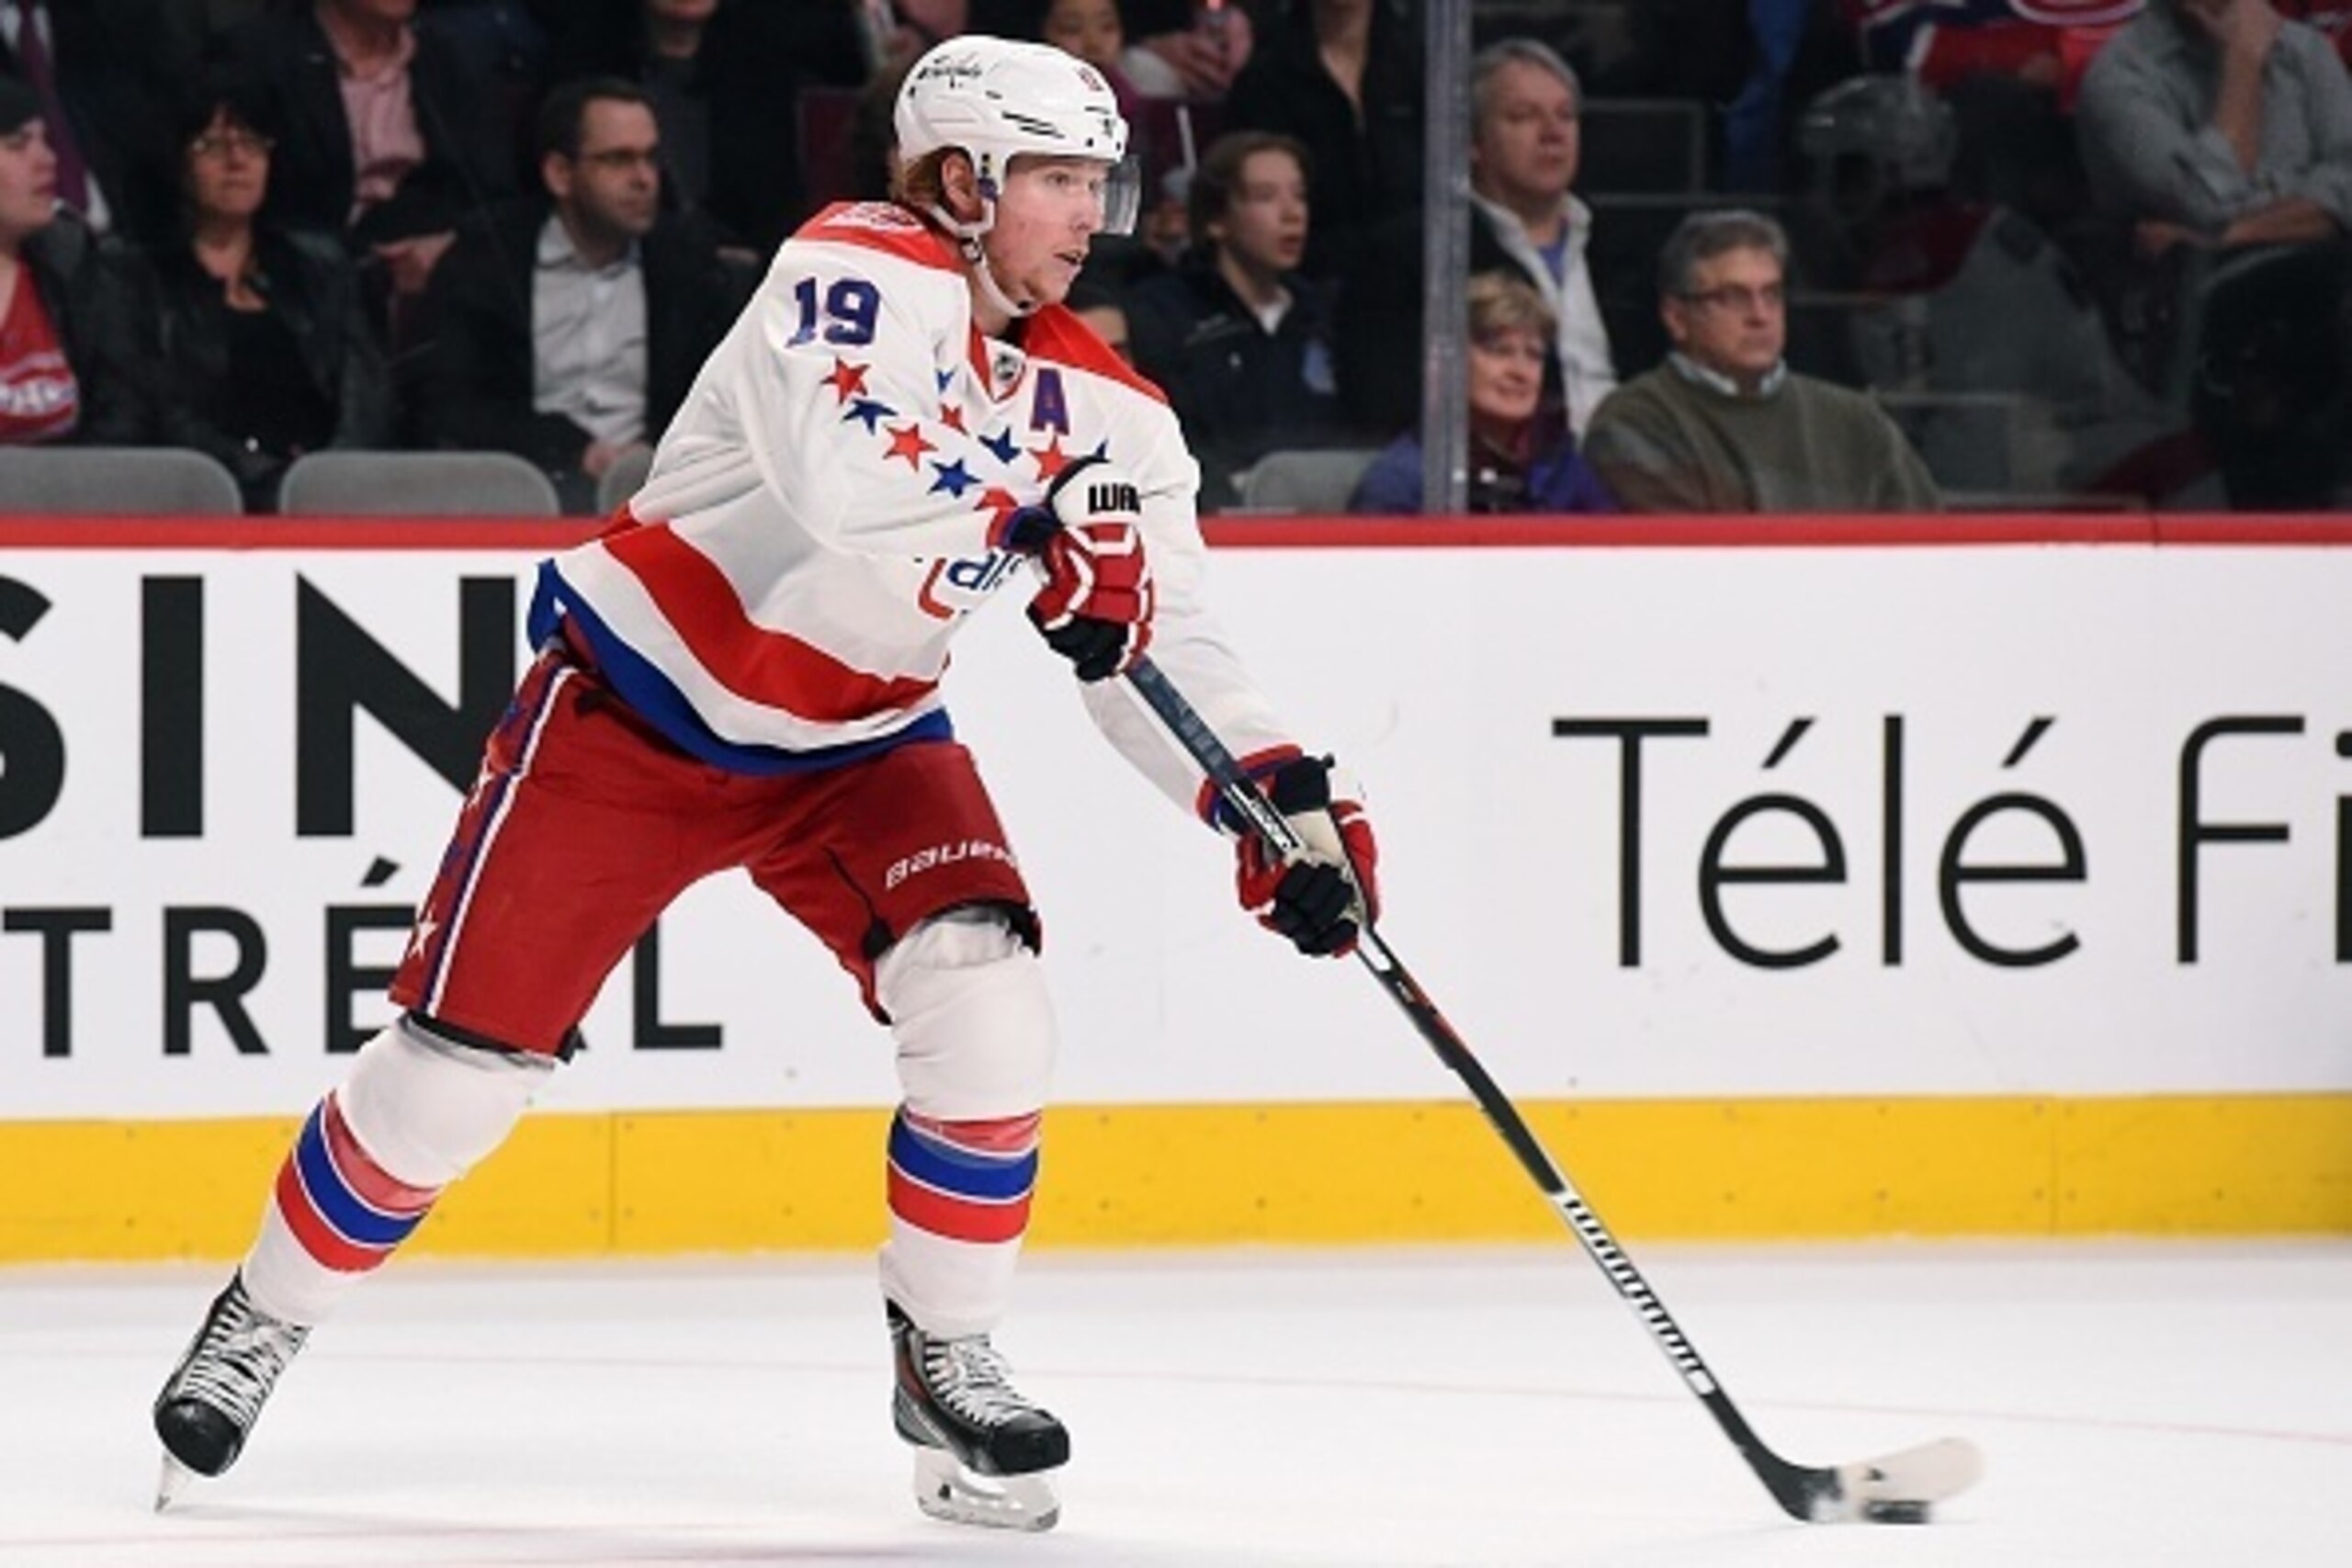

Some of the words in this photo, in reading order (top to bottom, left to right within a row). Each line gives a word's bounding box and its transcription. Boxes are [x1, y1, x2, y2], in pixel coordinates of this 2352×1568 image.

[786, 277, 880, 346] 19
[1029, 368, 1070, 436] A
[1553, 716, 2088, 970] Télé
[2, 856, 723, 1059] TRÉL
